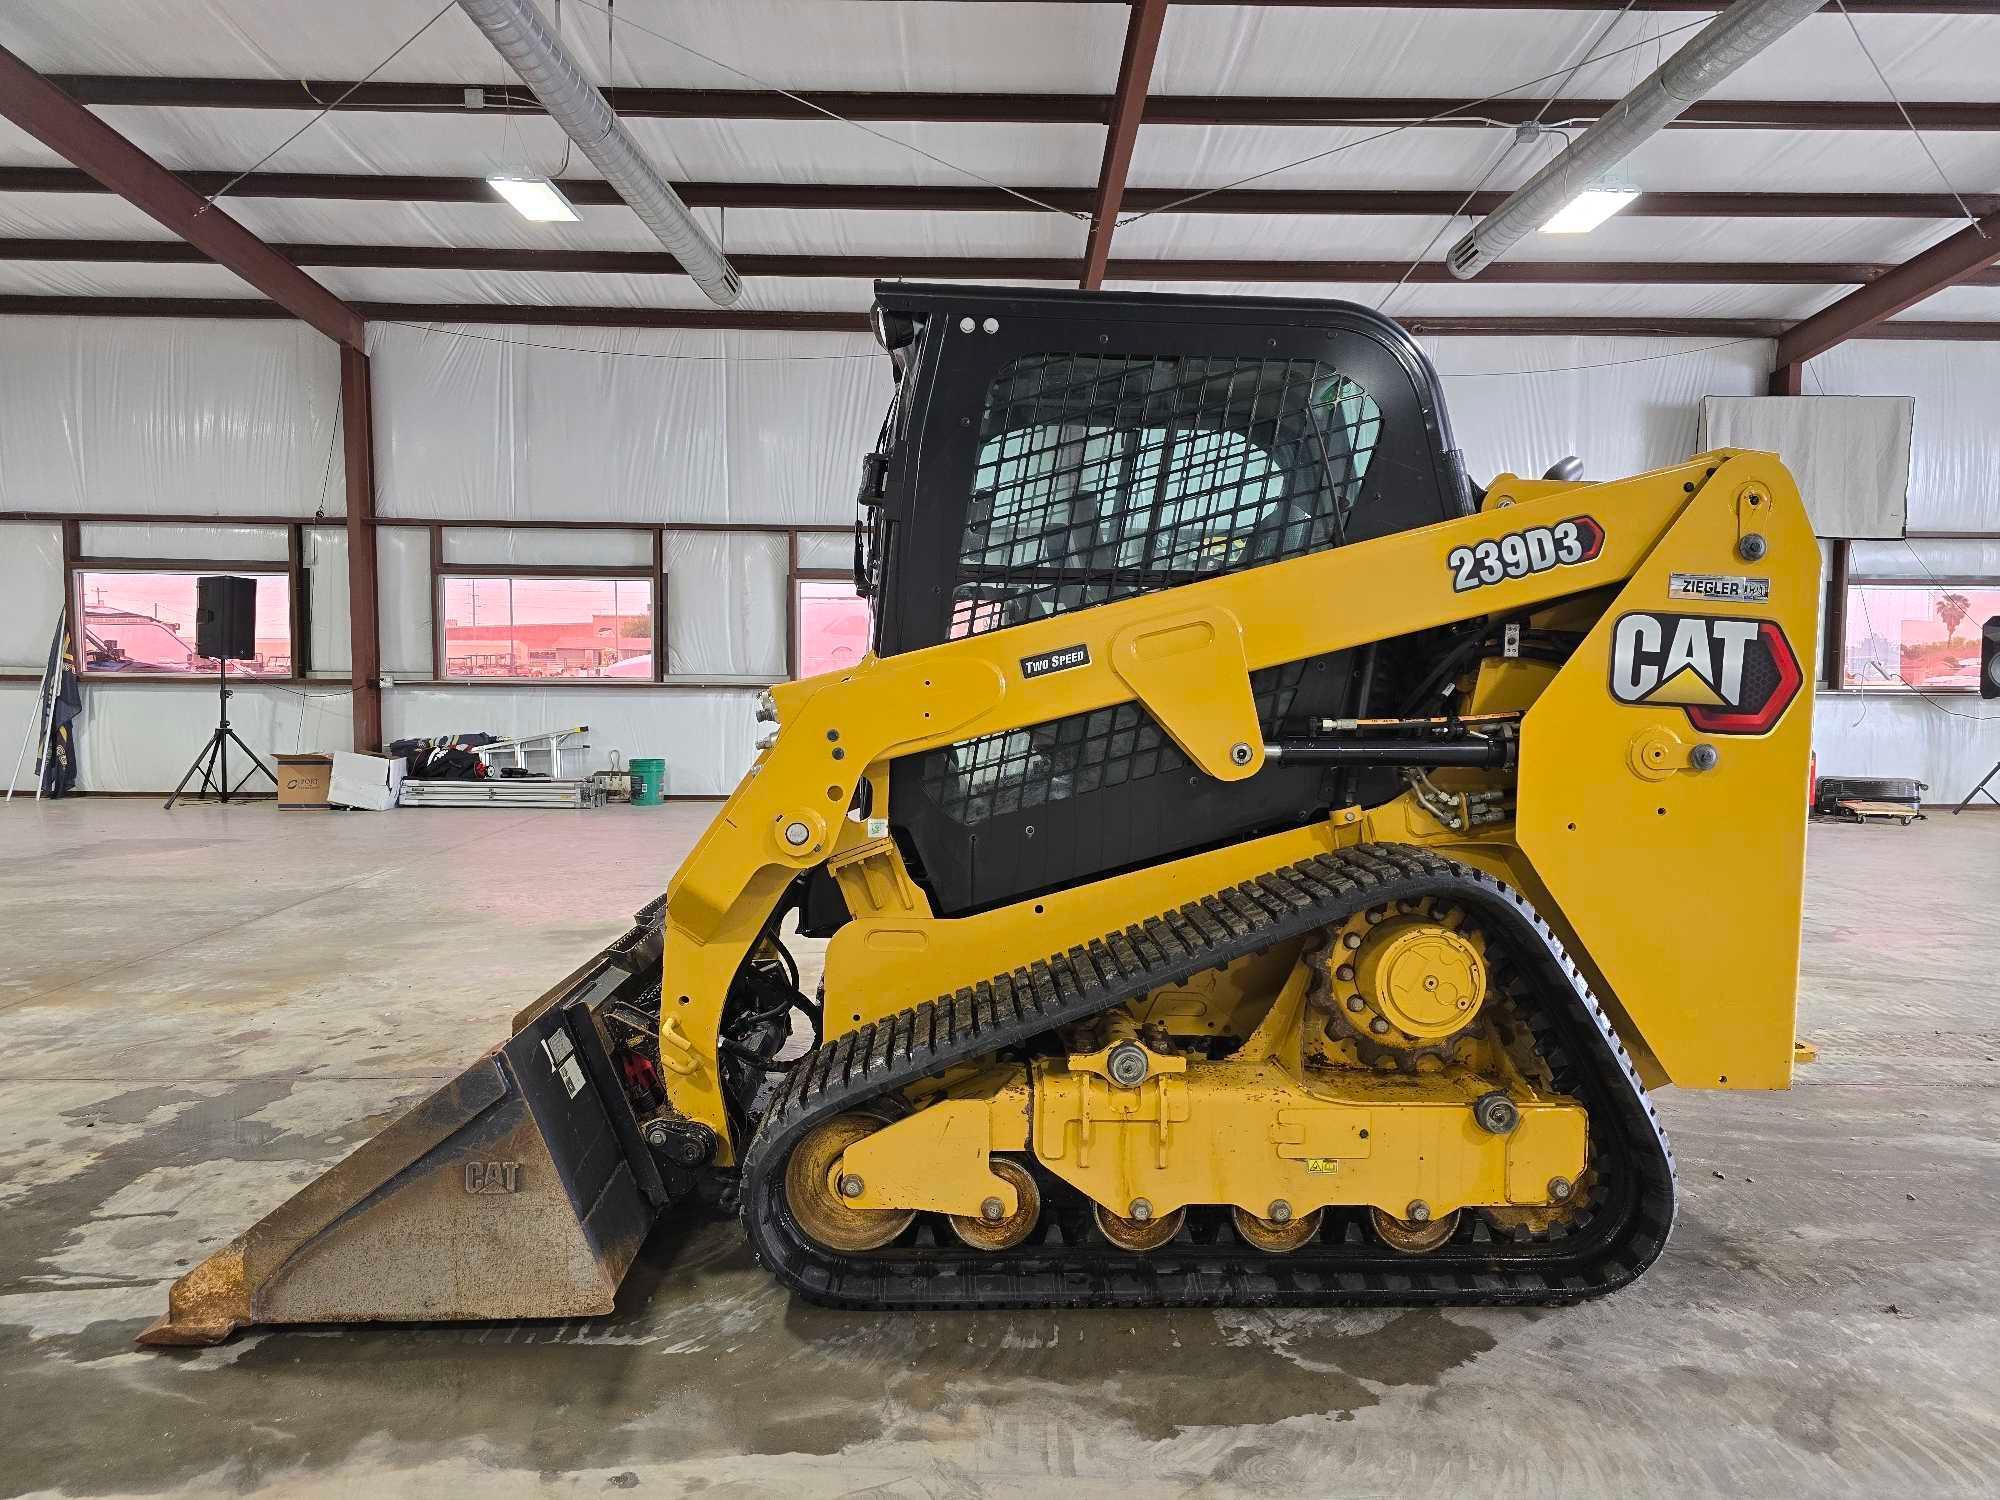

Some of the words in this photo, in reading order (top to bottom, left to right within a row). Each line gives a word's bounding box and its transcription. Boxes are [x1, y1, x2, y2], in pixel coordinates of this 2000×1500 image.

[1450, 522, 1582, 590] 239D3
[1682, 580, 1739, 595] ZIEGLER
[1025, 660, 1049, 674] TWO
[1051, 651, 1084, 667] SPEED
[1613, 614, 1759, 706] CAT
[465, 1162, 519, 1193] CAT
